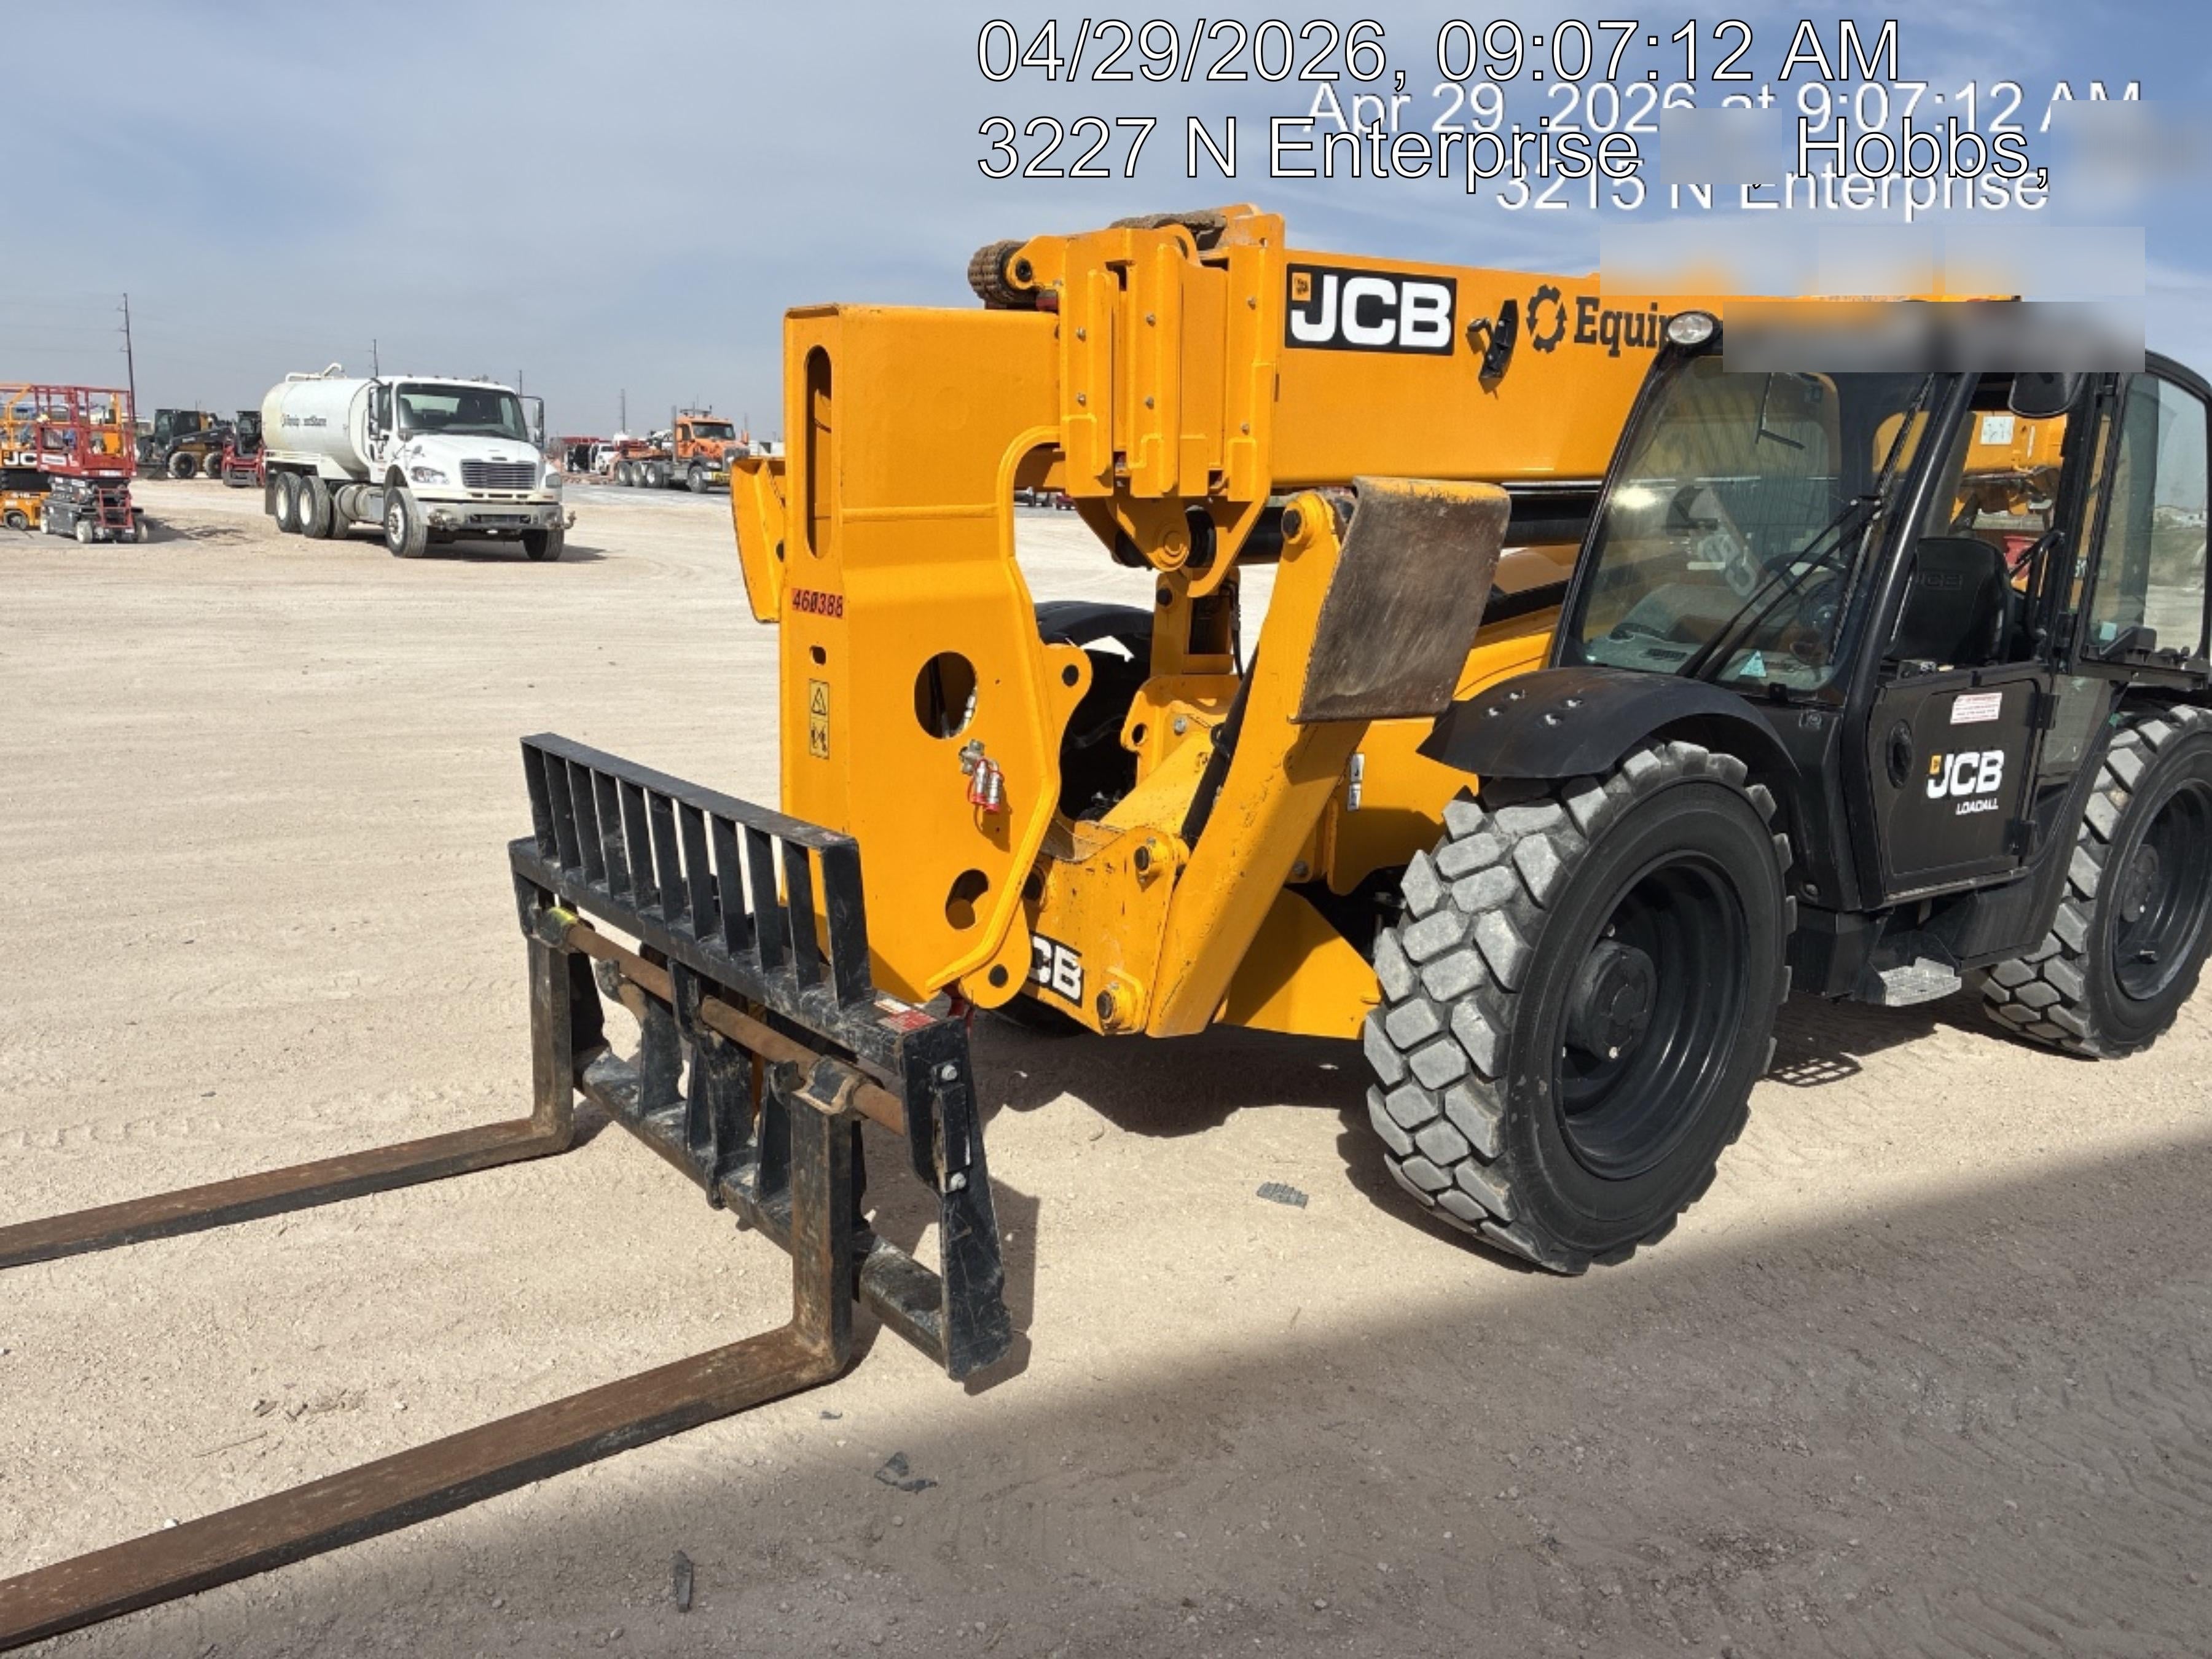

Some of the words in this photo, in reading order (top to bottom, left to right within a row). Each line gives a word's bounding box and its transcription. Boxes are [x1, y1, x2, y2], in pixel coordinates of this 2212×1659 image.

[1291, 274, 1453, 348] JCB
[4, 452, 37, 466] JC
[1926, 750, 2004, 799] JCB
[1955, 798, 1999, 815] LOADALL
[1032, 935, 1081, 1000] CB
